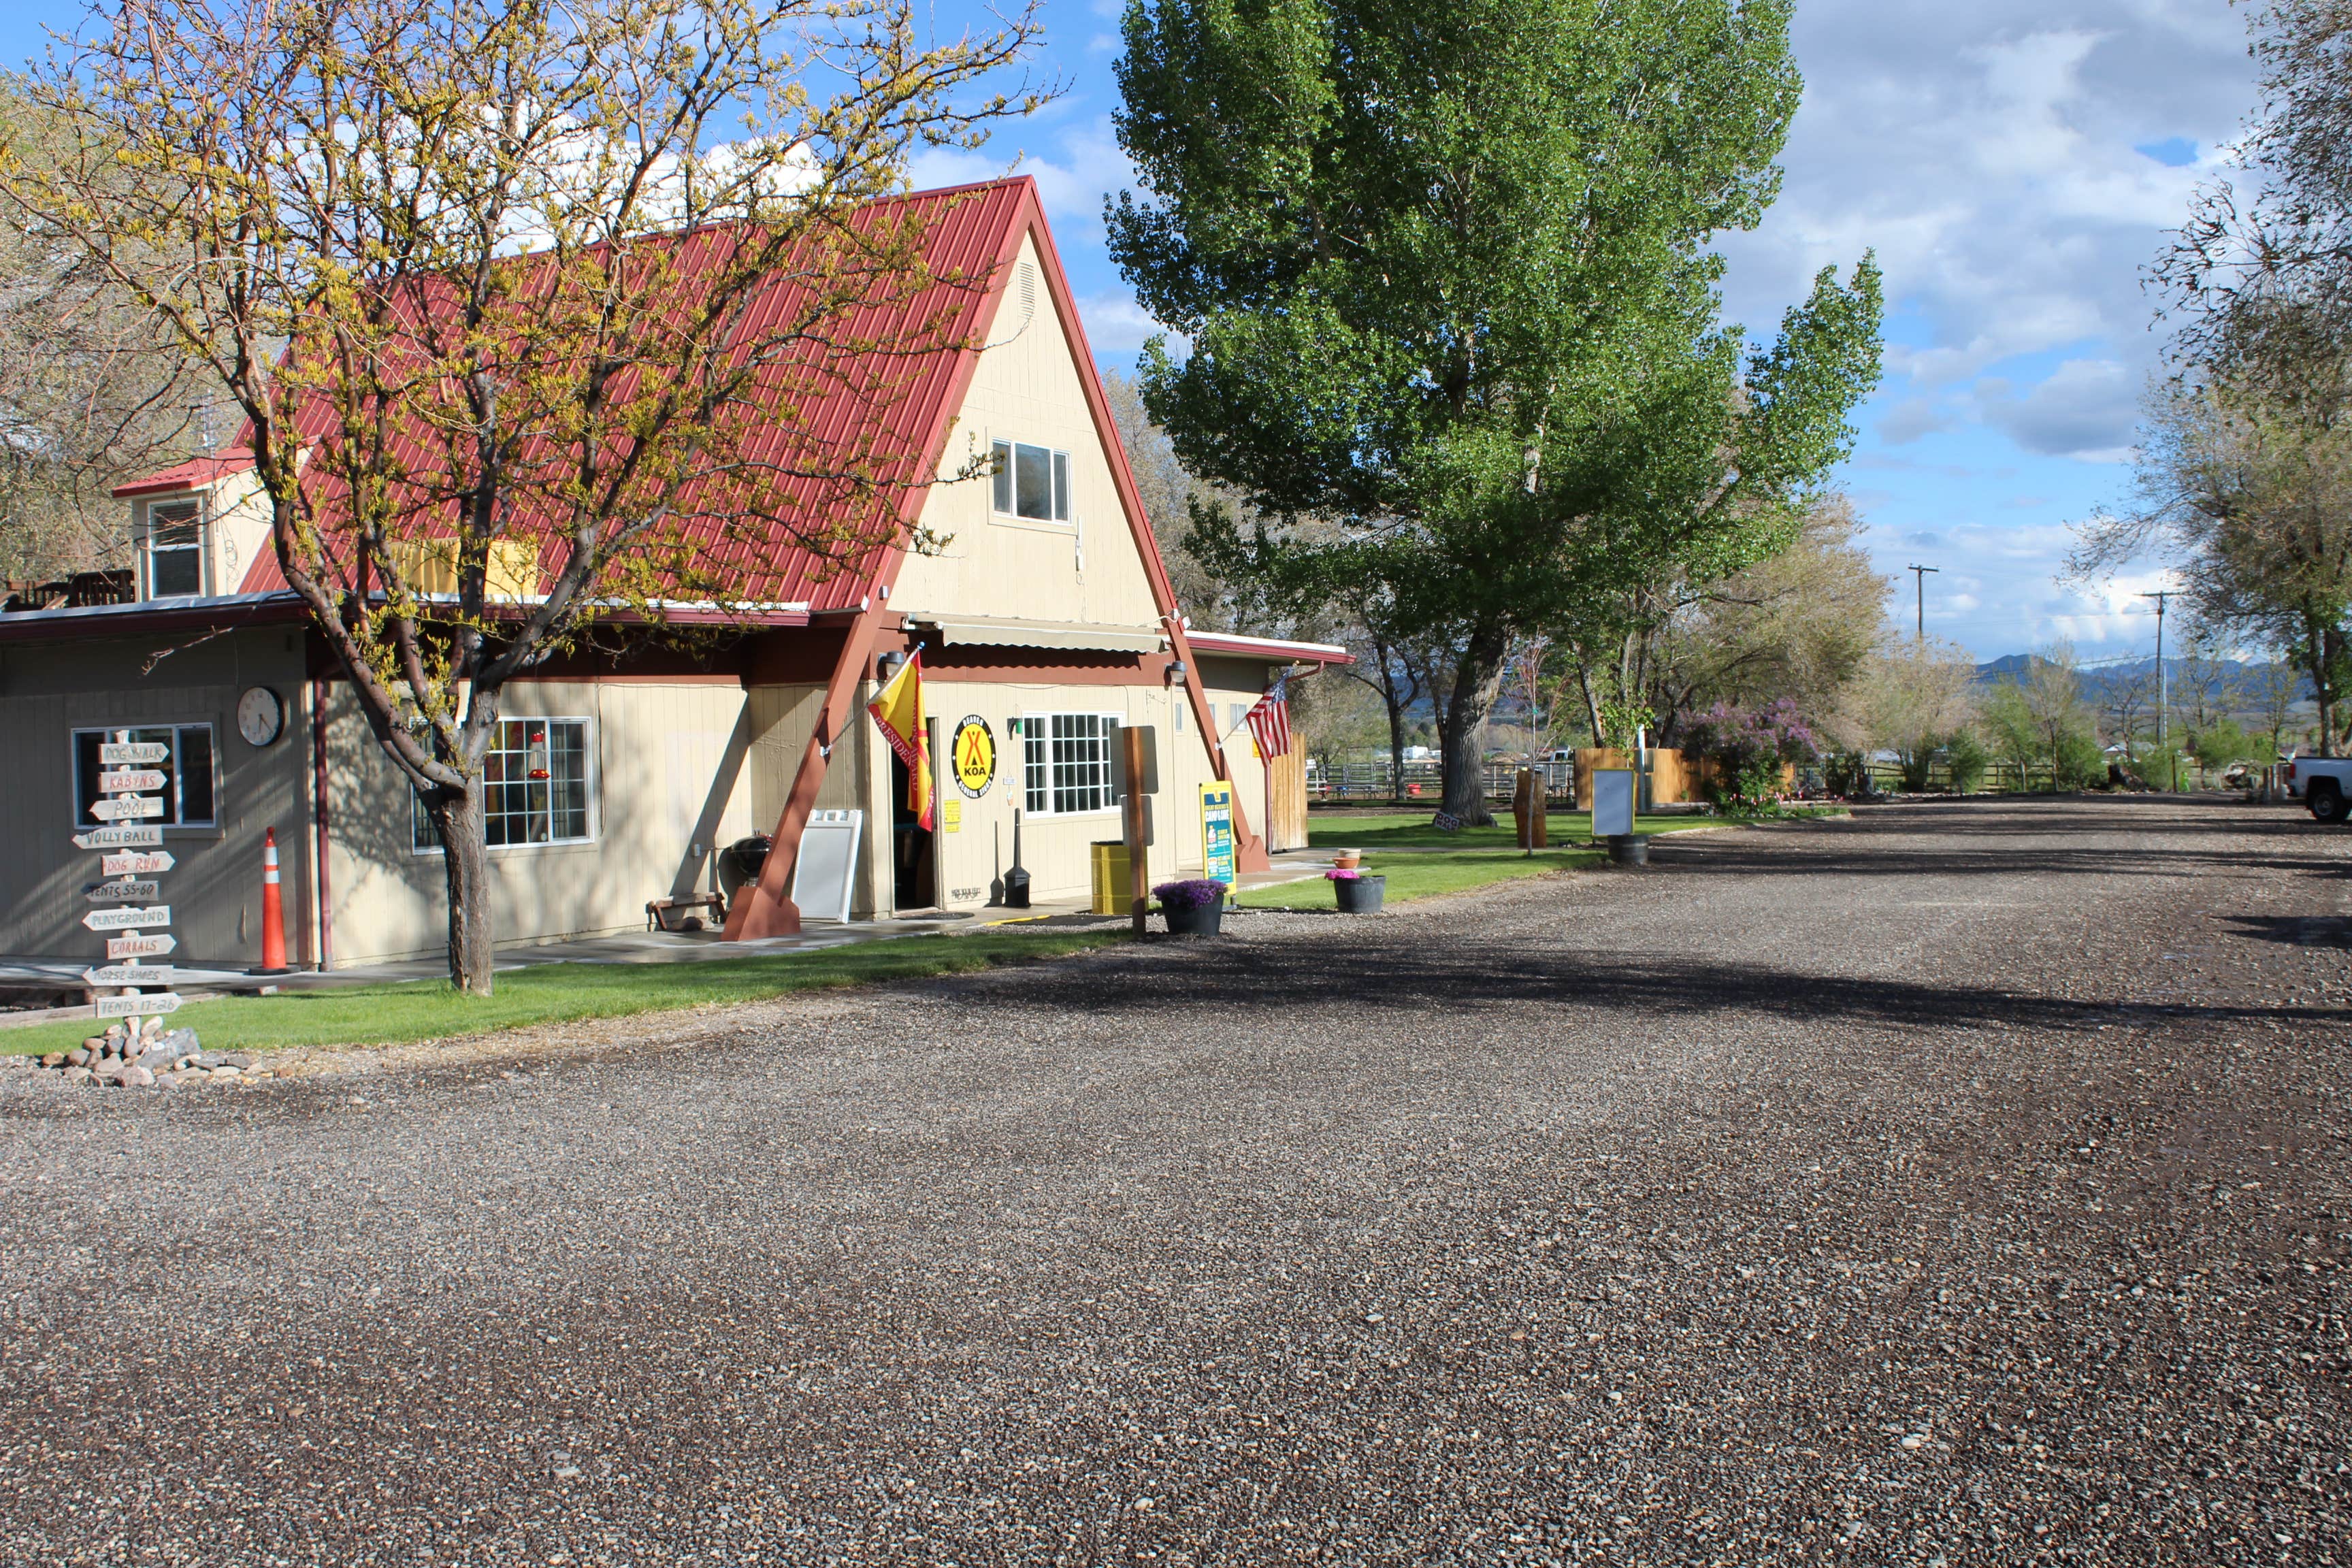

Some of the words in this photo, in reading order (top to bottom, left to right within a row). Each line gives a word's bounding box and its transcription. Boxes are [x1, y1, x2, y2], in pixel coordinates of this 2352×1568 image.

[875, 716, 913, 767] PRESIDEN
[106, 748, 127, 760] DOG
[131, 747, 162, 759] WALK
[964, 766, 987, 777] KOA
[114, 801, 148, 817] POOL
[1437, 813, 1458, 827] DOG
[108, 860, 127, 872] DOG
[135, 858, 160, 870] RUN
[90, 886, 120, 898] TENTS
[92, 911, 165, 926] PLAYGROUND
[112, 940, 158, 955] CORRALS
[102, 1001, 135, 1014] TENTS
[140, 999, 175, 1012] 17-26
